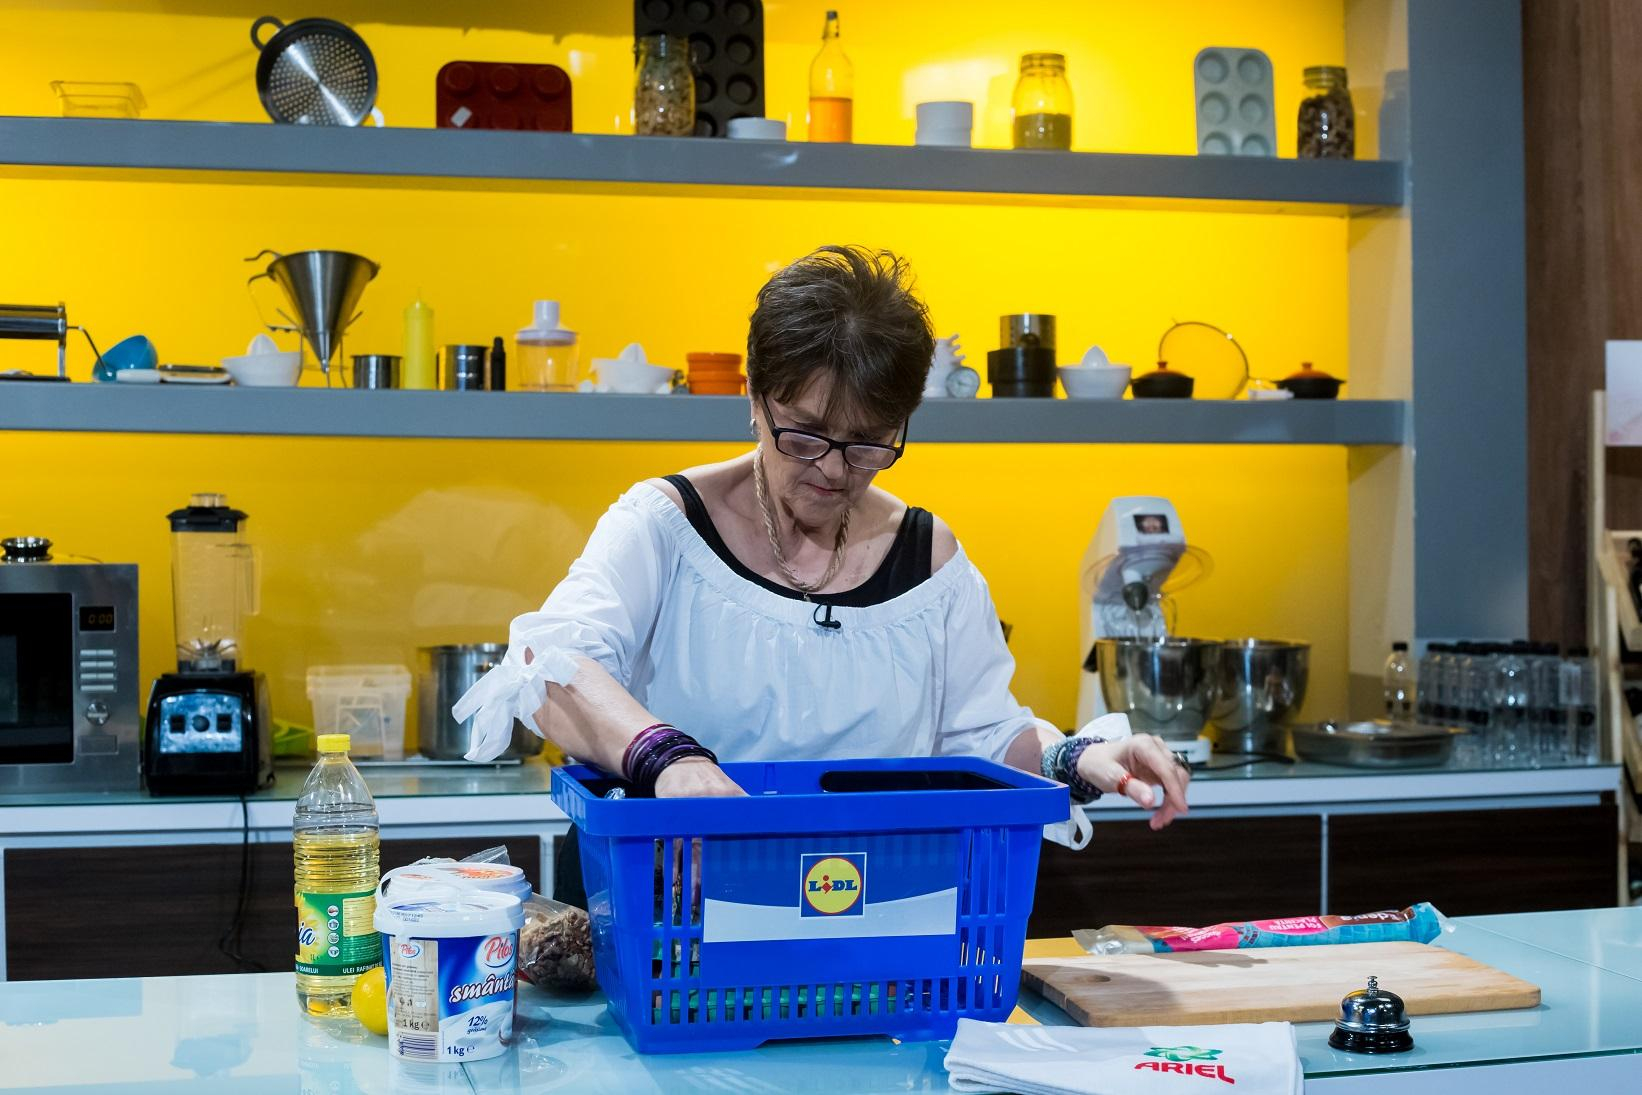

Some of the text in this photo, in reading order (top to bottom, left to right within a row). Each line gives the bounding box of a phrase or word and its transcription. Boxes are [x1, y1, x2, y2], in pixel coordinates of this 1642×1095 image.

[485, 936, 513, 961] Pilos
[409, 1019, 420, 1031] kg
[468, 1015, 489, 1027] 12%
[447, 1046, 465, 1057] 1 kg
[1134, 1061, 1235, 1084] ARIEL
